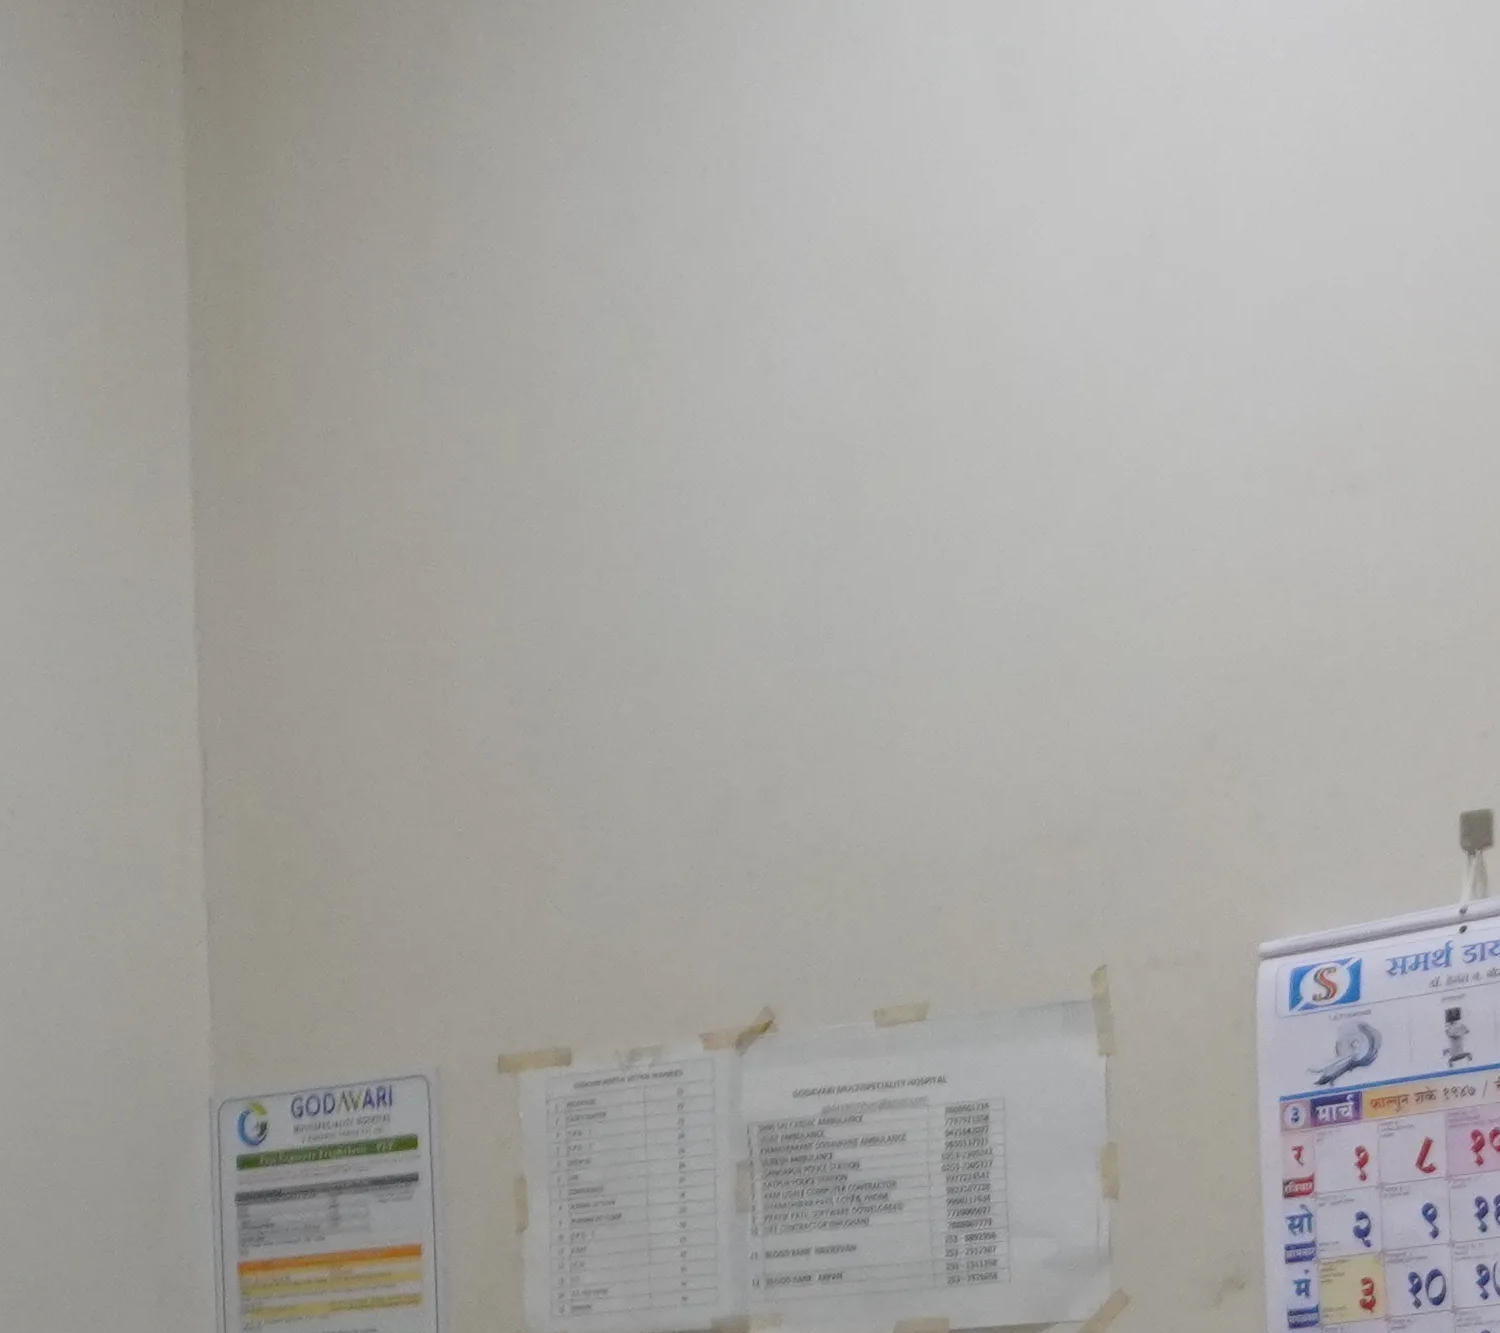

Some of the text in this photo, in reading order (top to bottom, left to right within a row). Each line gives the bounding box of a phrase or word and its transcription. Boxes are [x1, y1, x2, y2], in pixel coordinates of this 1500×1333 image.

[1385, 938, 1453, 977] समर्थ
[908, 1075, 947, 1088] HOSPITAL
[291, 1085, 393, 1119] GODAVARI
[1315, 1095, 1355, 1121] मार्च
[1370, 1091, 1410, 1113] फाल्गुन
[1354, 1145, 1369, 1182] १
[1415, 1137, 1436, 1174] ८
[1352, 1210, 1373, 1248] २
[1421, 1202, 1440, 1239] ९
[1359, 1276, 1376, 1314] ३
[1407, 1268, 1447, 1308] १०
